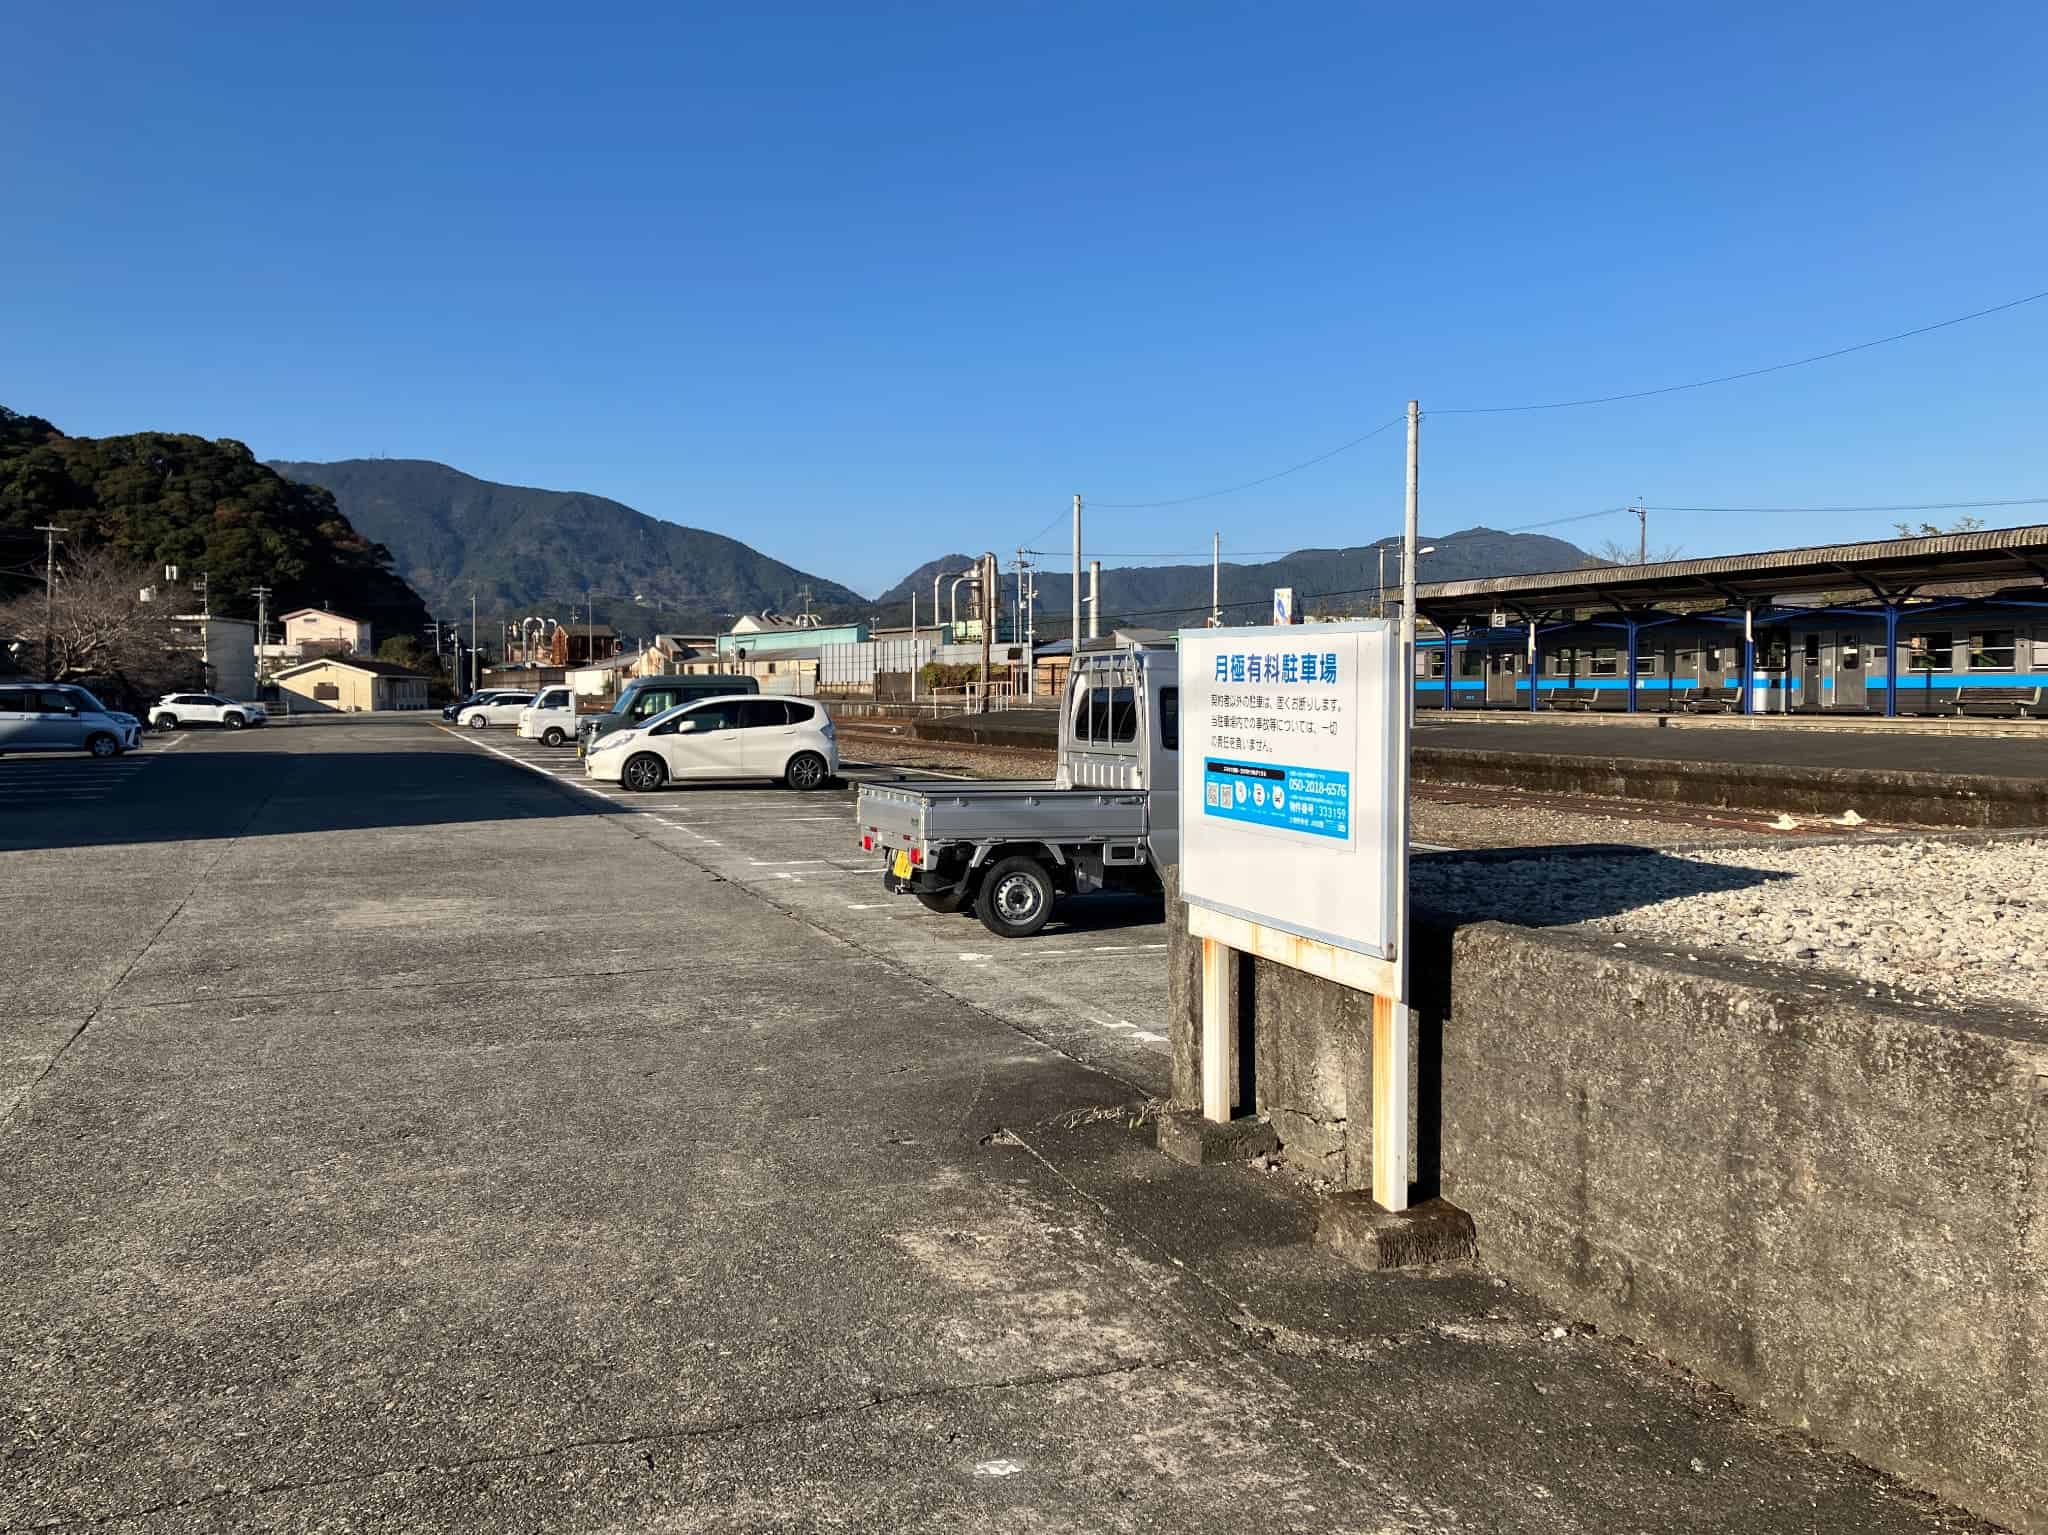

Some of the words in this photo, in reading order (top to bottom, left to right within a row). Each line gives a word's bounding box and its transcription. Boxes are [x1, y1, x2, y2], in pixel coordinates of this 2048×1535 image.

[1495, 616, 1505, 626] 2
[1215, 653, 1337, 684] 月極有料駐車場
